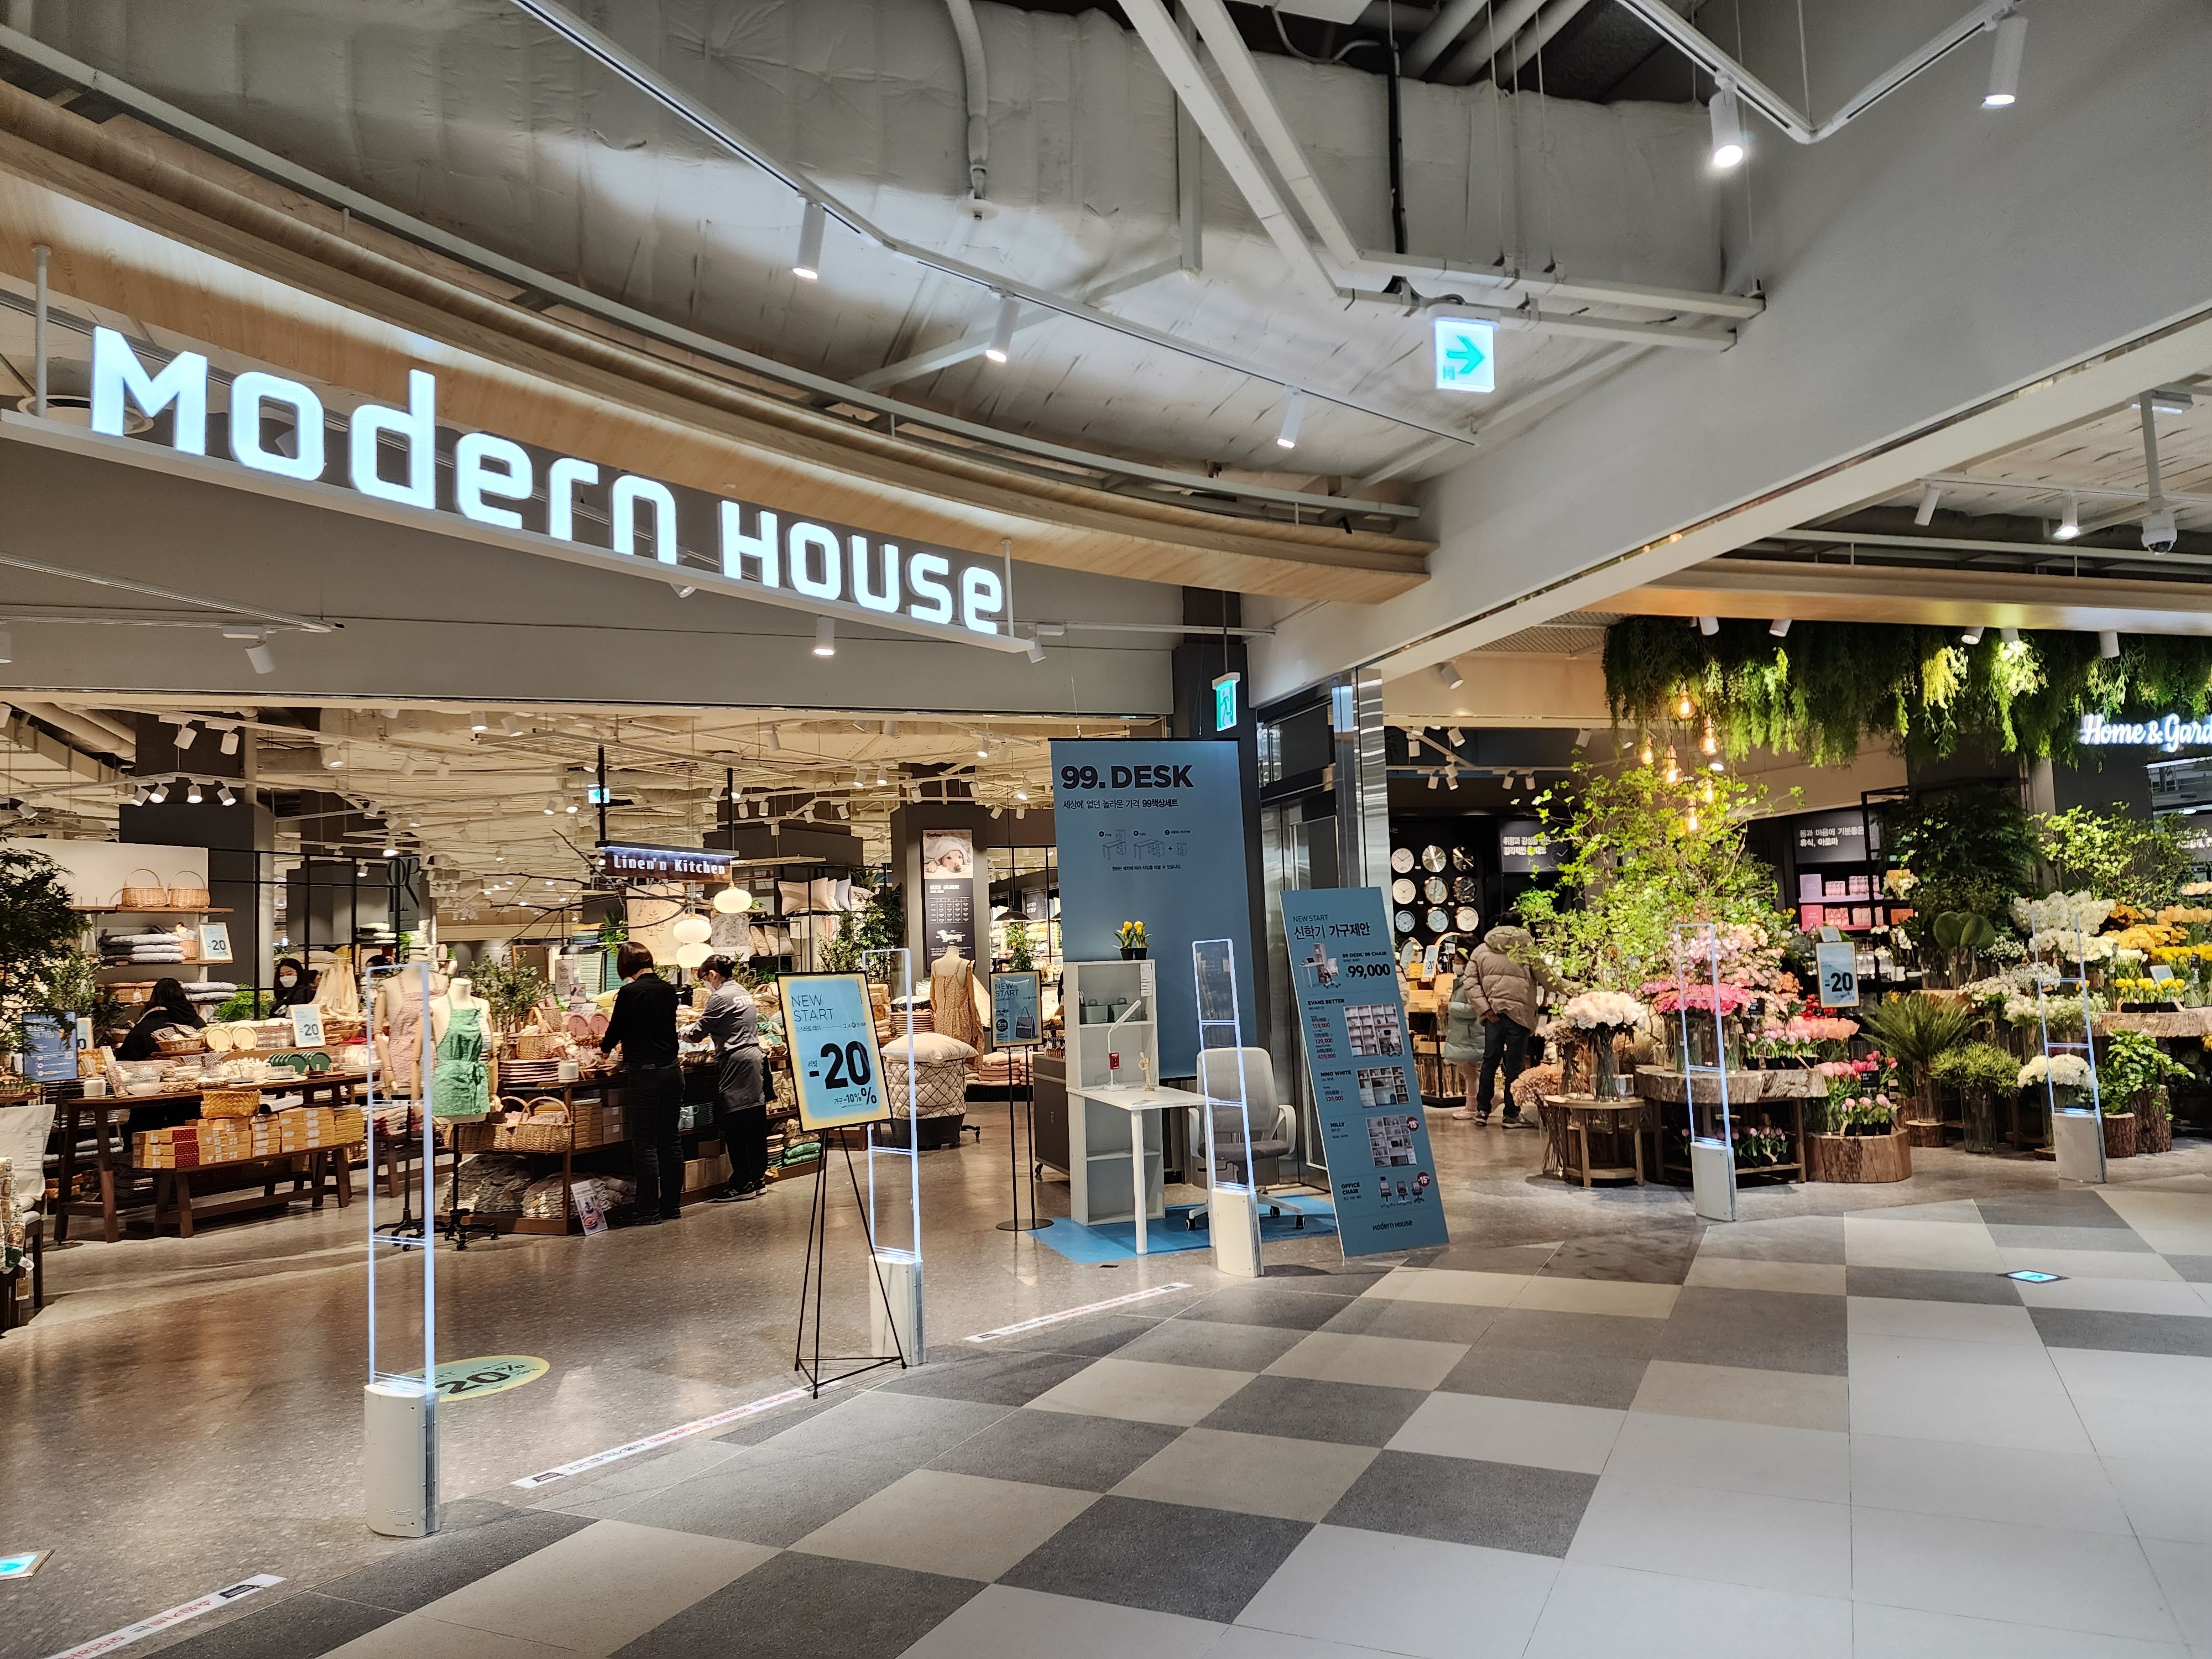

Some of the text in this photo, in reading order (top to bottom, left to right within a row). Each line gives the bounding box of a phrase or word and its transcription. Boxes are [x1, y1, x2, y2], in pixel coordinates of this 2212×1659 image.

[2080, 713, 2146, 745] Home
[1111, 765, 1194, 789] DESK
[1063, 799, 1178, 809] 세상에 없던 놀라운 가격 99책상세트
[1815, 827, 1835, 837] 마음에
[1818, 837, 1839, 846] 아로마
[613, 854, 726, 875] Linen'n Kitchen
[1294, 922, 1370, 940] 신학기 가구제안
[1348, 963, 1391, 979] 99,000
[791, 994, 822, 1008] NEW
[794, 1008, 834, 1022] START
